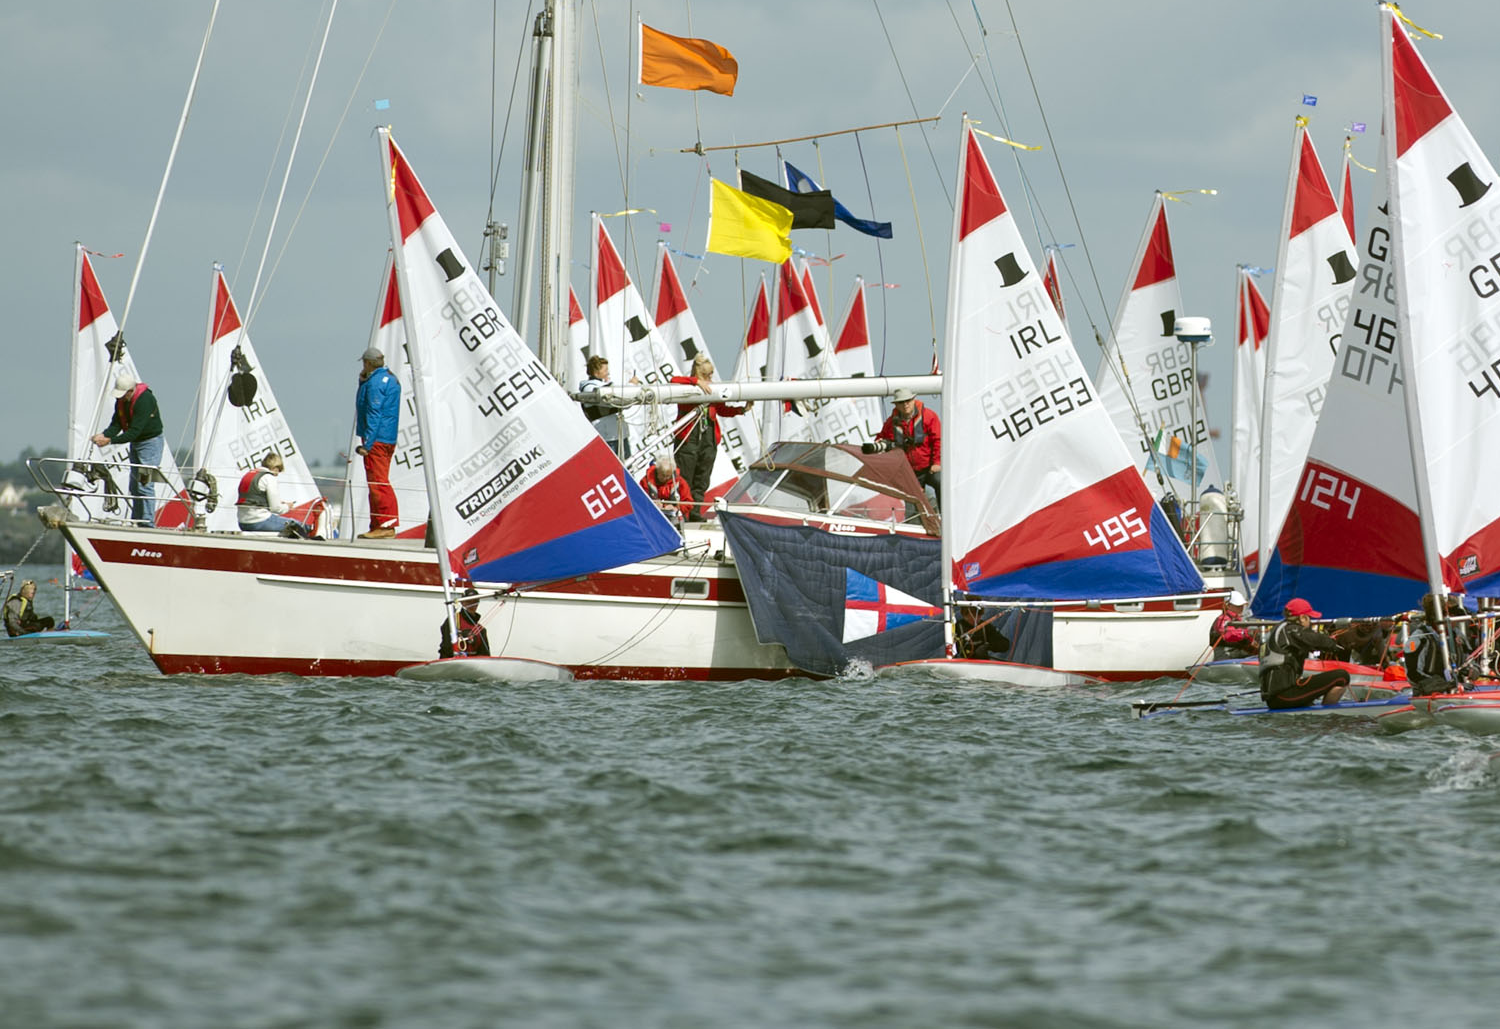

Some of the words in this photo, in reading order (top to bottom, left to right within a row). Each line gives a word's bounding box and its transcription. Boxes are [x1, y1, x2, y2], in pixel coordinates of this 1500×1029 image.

[459, 306, 505, 352] GBR
[1010, 319, 1061, 359] IRL
[478, 361, 551, 417] 46541
[1151, 367, 1194, 401] GBR
[242, 398, 276, 423] IRL
[990, 377, 1093, 443] 46253
[459, 460, 519, 516] TRIDENT
[467, 516, 480, 526] The
[480, 499, 502, 517] Dinghy
[502, 483, 519, 499] Shop
[519, 476, 528, 485] on
[527, 468, 539, 478] the
[580, 474, 627, 520] 613
[1301, 469, 1360, 519] 124
[1083, 507, 1148, 550] 495
